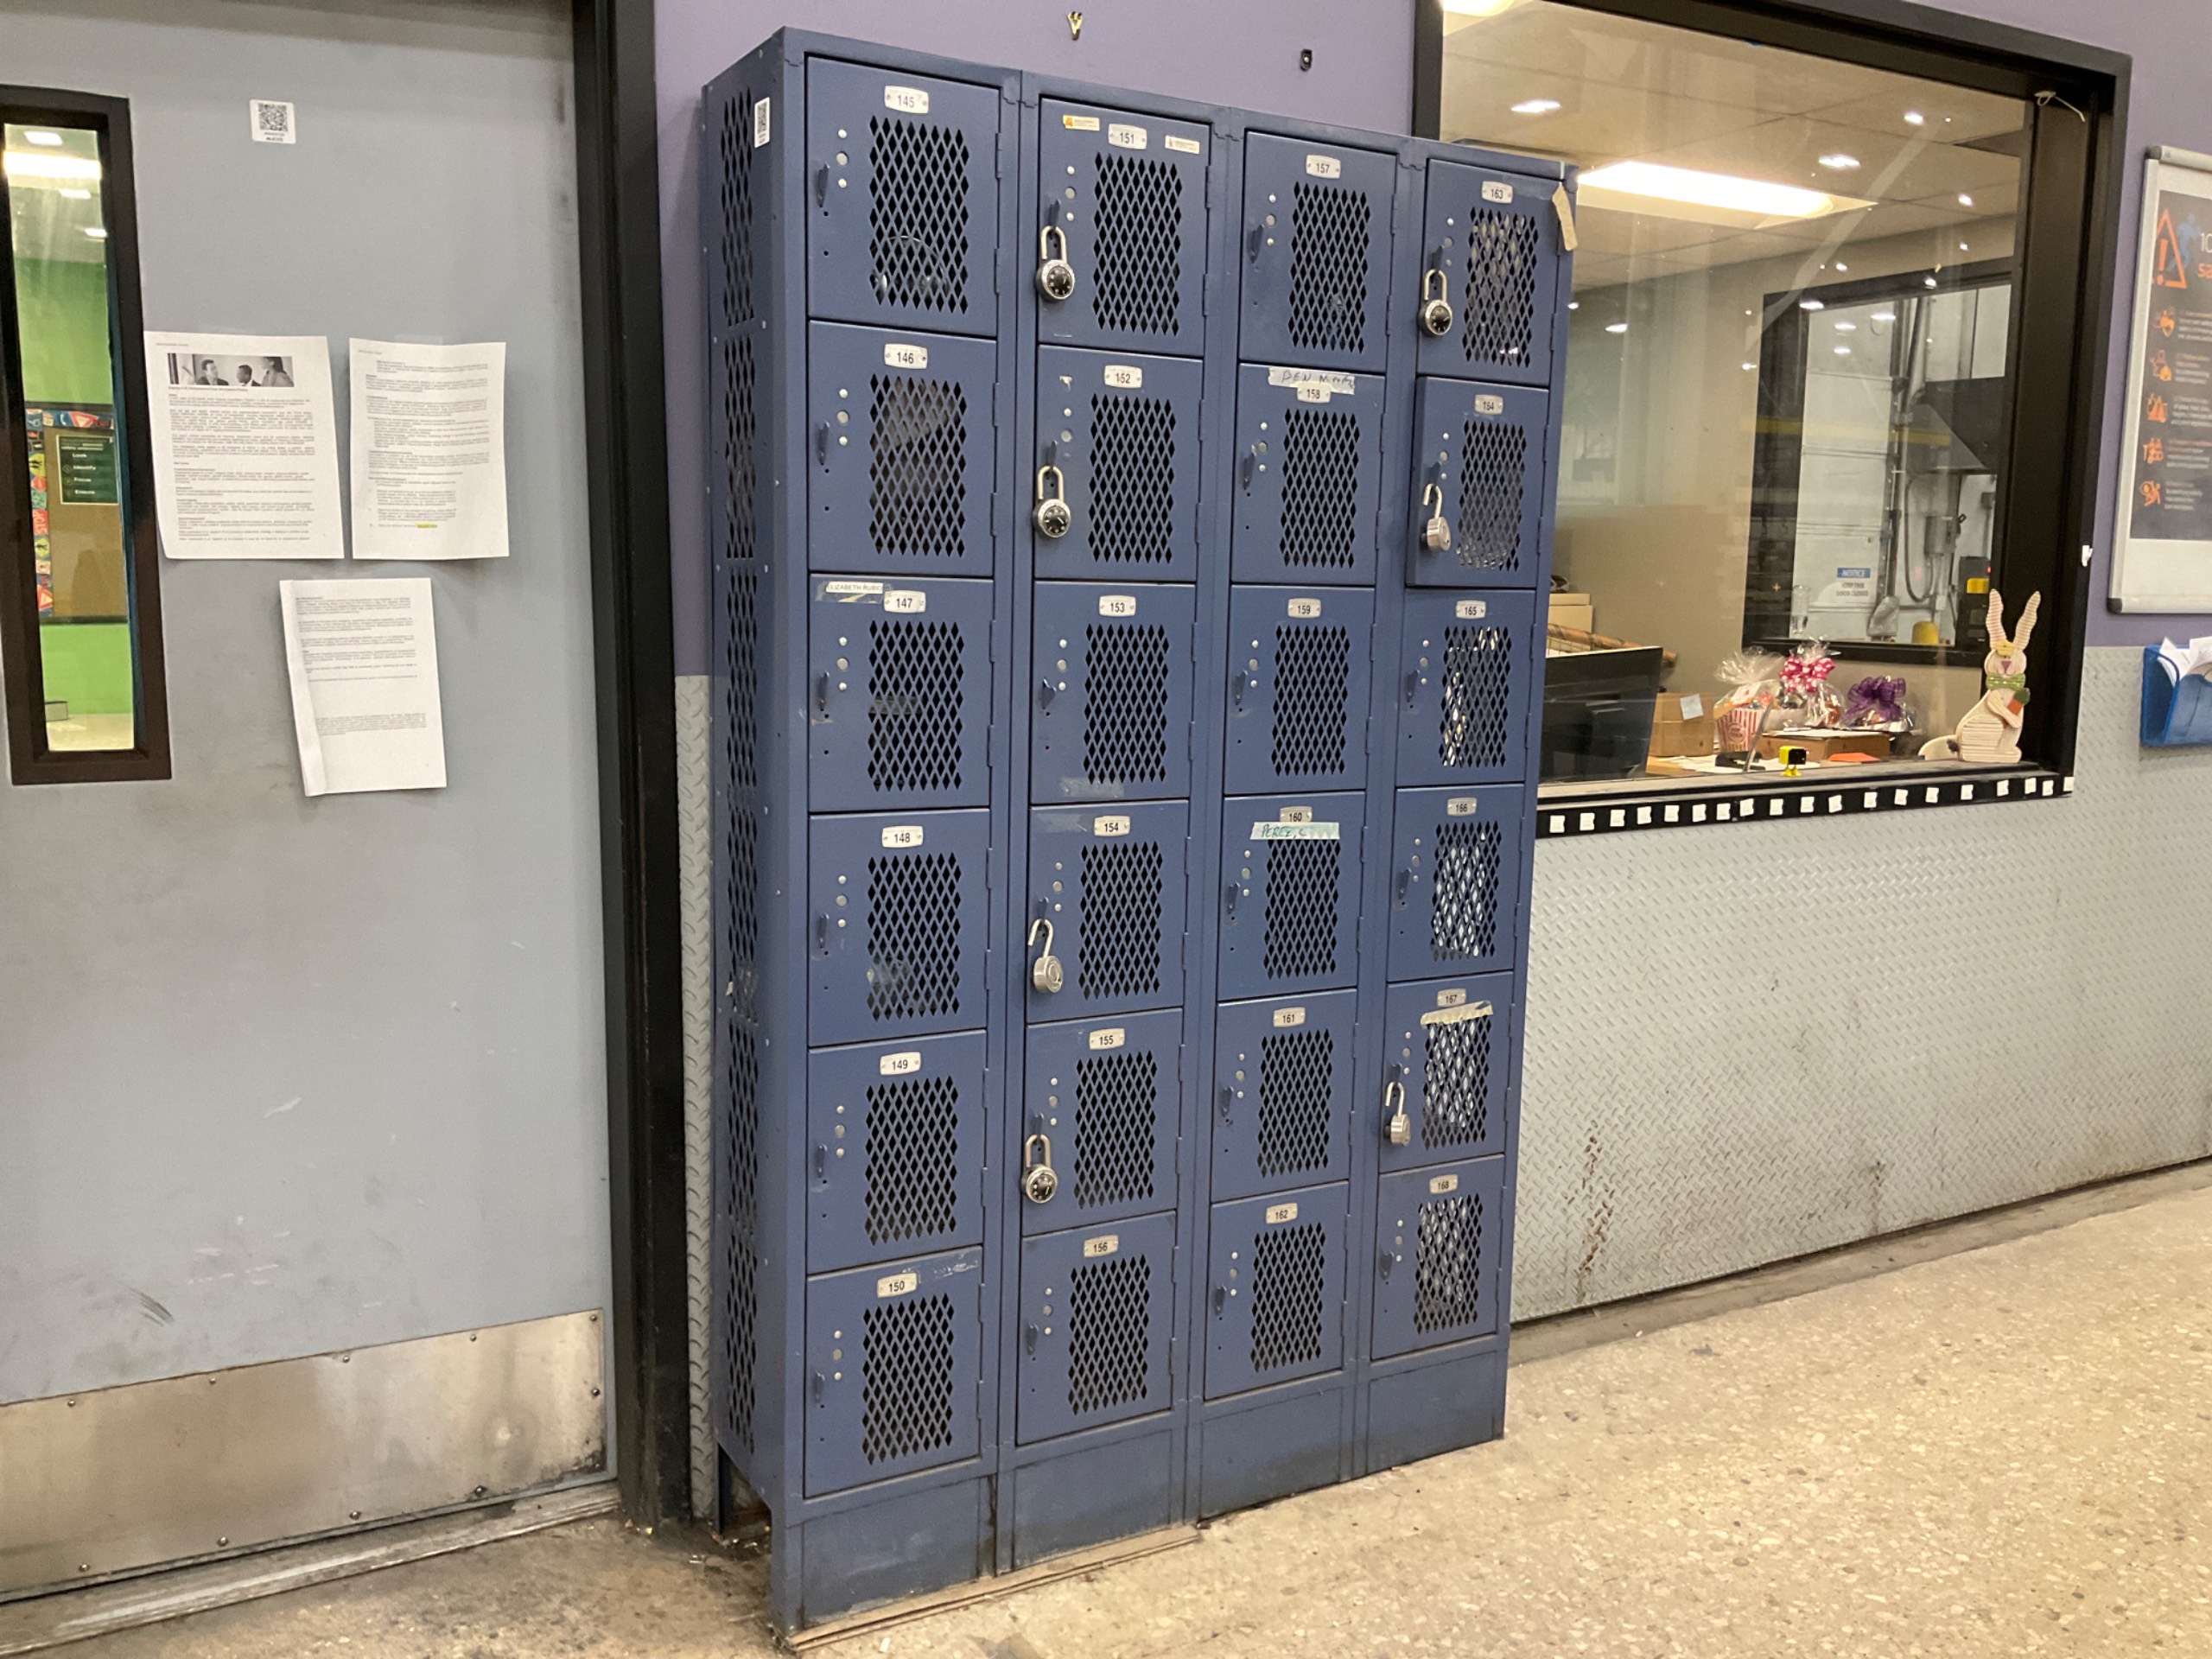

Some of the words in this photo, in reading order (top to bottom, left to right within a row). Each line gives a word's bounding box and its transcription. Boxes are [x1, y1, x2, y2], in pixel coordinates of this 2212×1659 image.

[898, 95, 914, 107] 145
[1120, 132, 1134, 144] 151
[1317, 162, 1329, 173] 157
[1491, 188, 1503, 199] 163
[898, 352, 914, 364] 146
[1116, 372, 1130, 384] 152
[1307, 389, 1320, 399] 158
[1483, 401, 1494, 410] 164
[896, 597, 912, 608] 147
[1110, 602, 1124, 613] 153
[1298, 605, 1311, 614] 159
[1465, 606, 1477, 615] 165
[1456, 804, 1468, 812] 166
[1289, 812, 1302, 822] 160
[1104, 823, 1118, 832] 154
[894, 833, 911, 843] 148
[1446, 994, 1457, 1003] 167
[1282, 1014, 1294, 1022] 161
[1099, 1035, 1113, 1046] 155
[892, 1059, 908, 1070] 149
[1438, 1181, 1448, 1190] 168
[1275, 1210, 1287, 1219] 162
[1093, 1242, 1108, 1253] 156
[889, 1281, 905, 1292] 150
